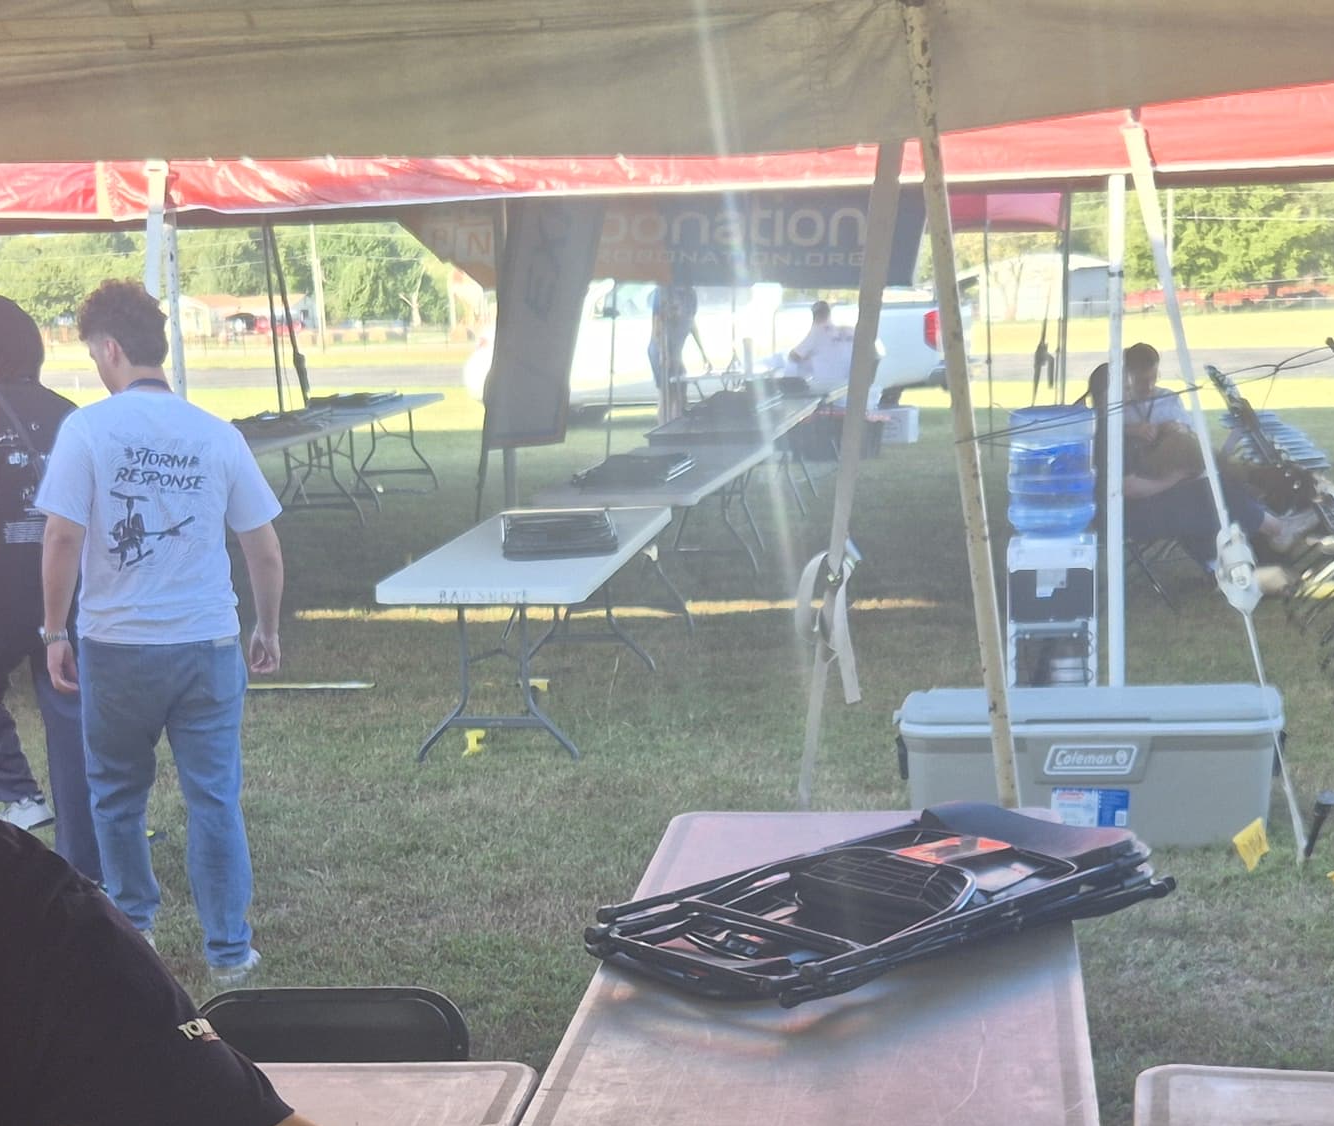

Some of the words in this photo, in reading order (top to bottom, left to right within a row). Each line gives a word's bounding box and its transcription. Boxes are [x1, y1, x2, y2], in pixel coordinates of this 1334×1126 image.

[599, 251, 865, 267] ROBONATON.ORG
[131, 447, 186, 469] STORM
[114, 466, 207, 491] RESPONSE
[1054, 750, 1113, 766] Coleman
